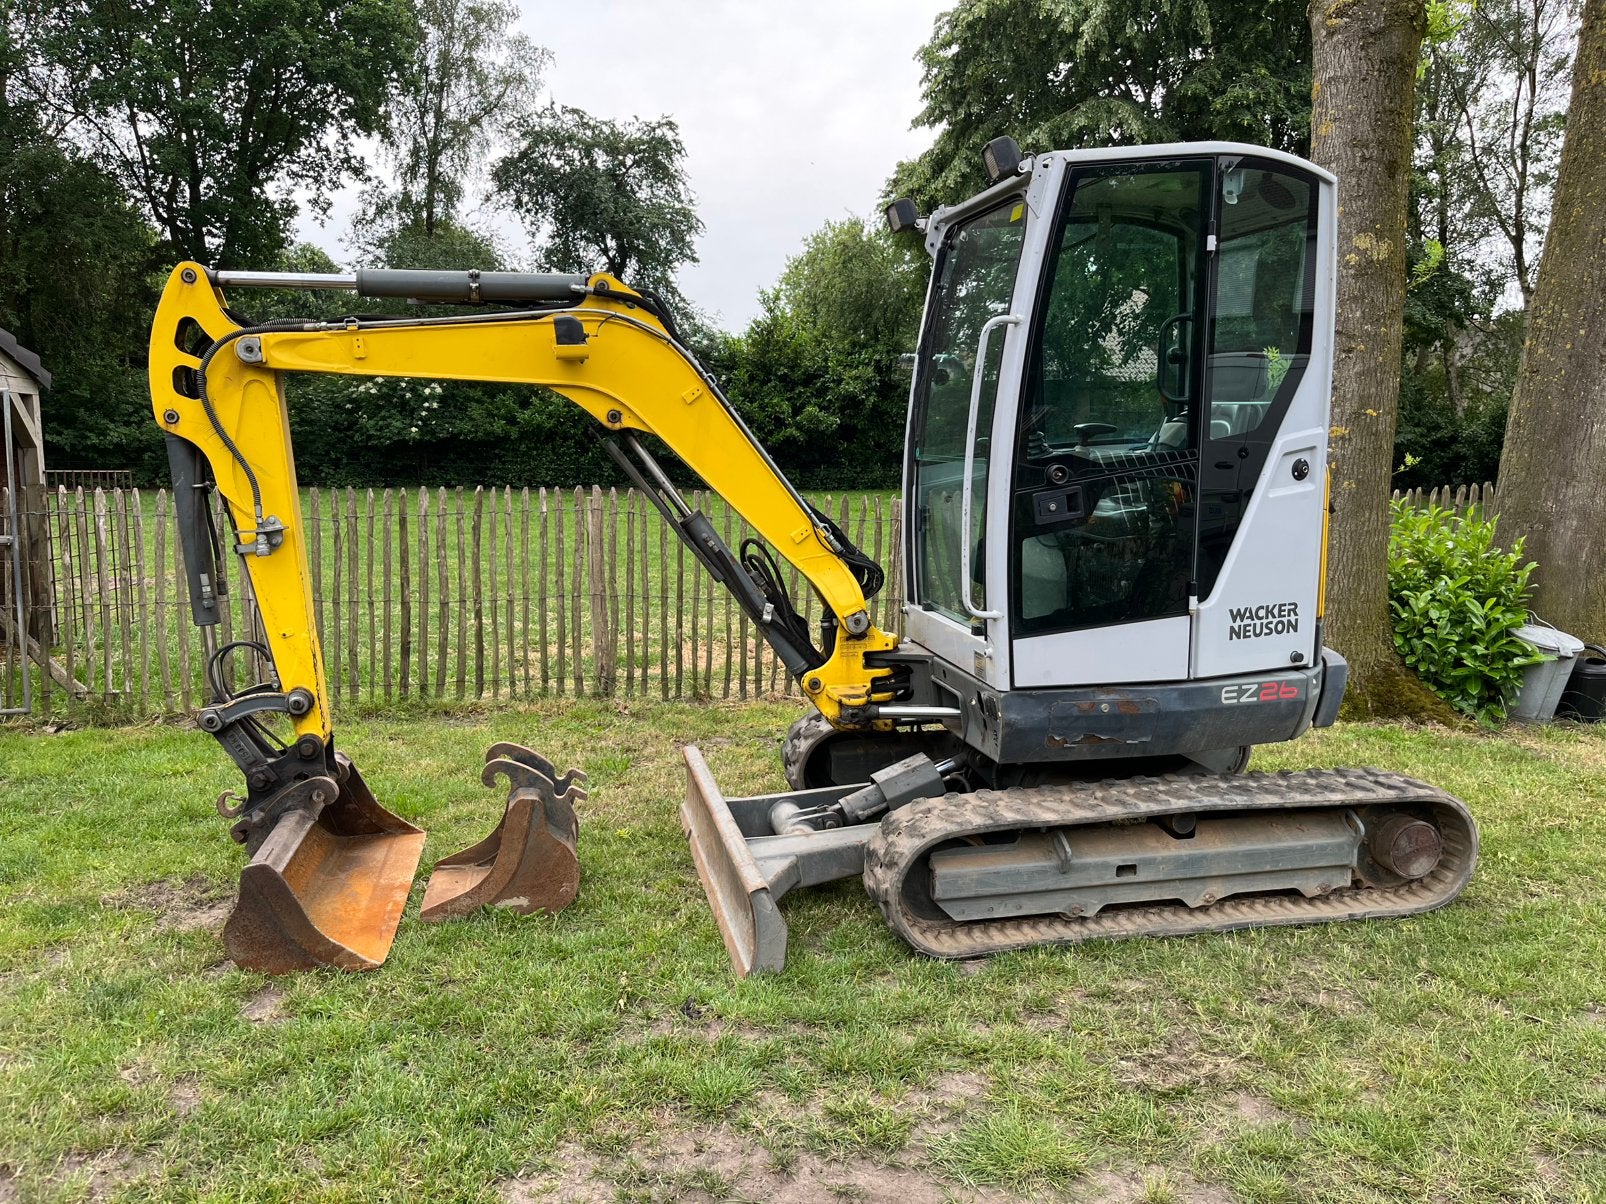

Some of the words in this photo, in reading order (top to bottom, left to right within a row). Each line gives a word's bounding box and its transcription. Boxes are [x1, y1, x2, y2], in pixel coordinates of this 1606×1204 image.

[1229, 602, 1298, 623] WACKER
[1229, 618, 1298, 640] NEUSON
[1221, 681, 1298, 704] EZ26
